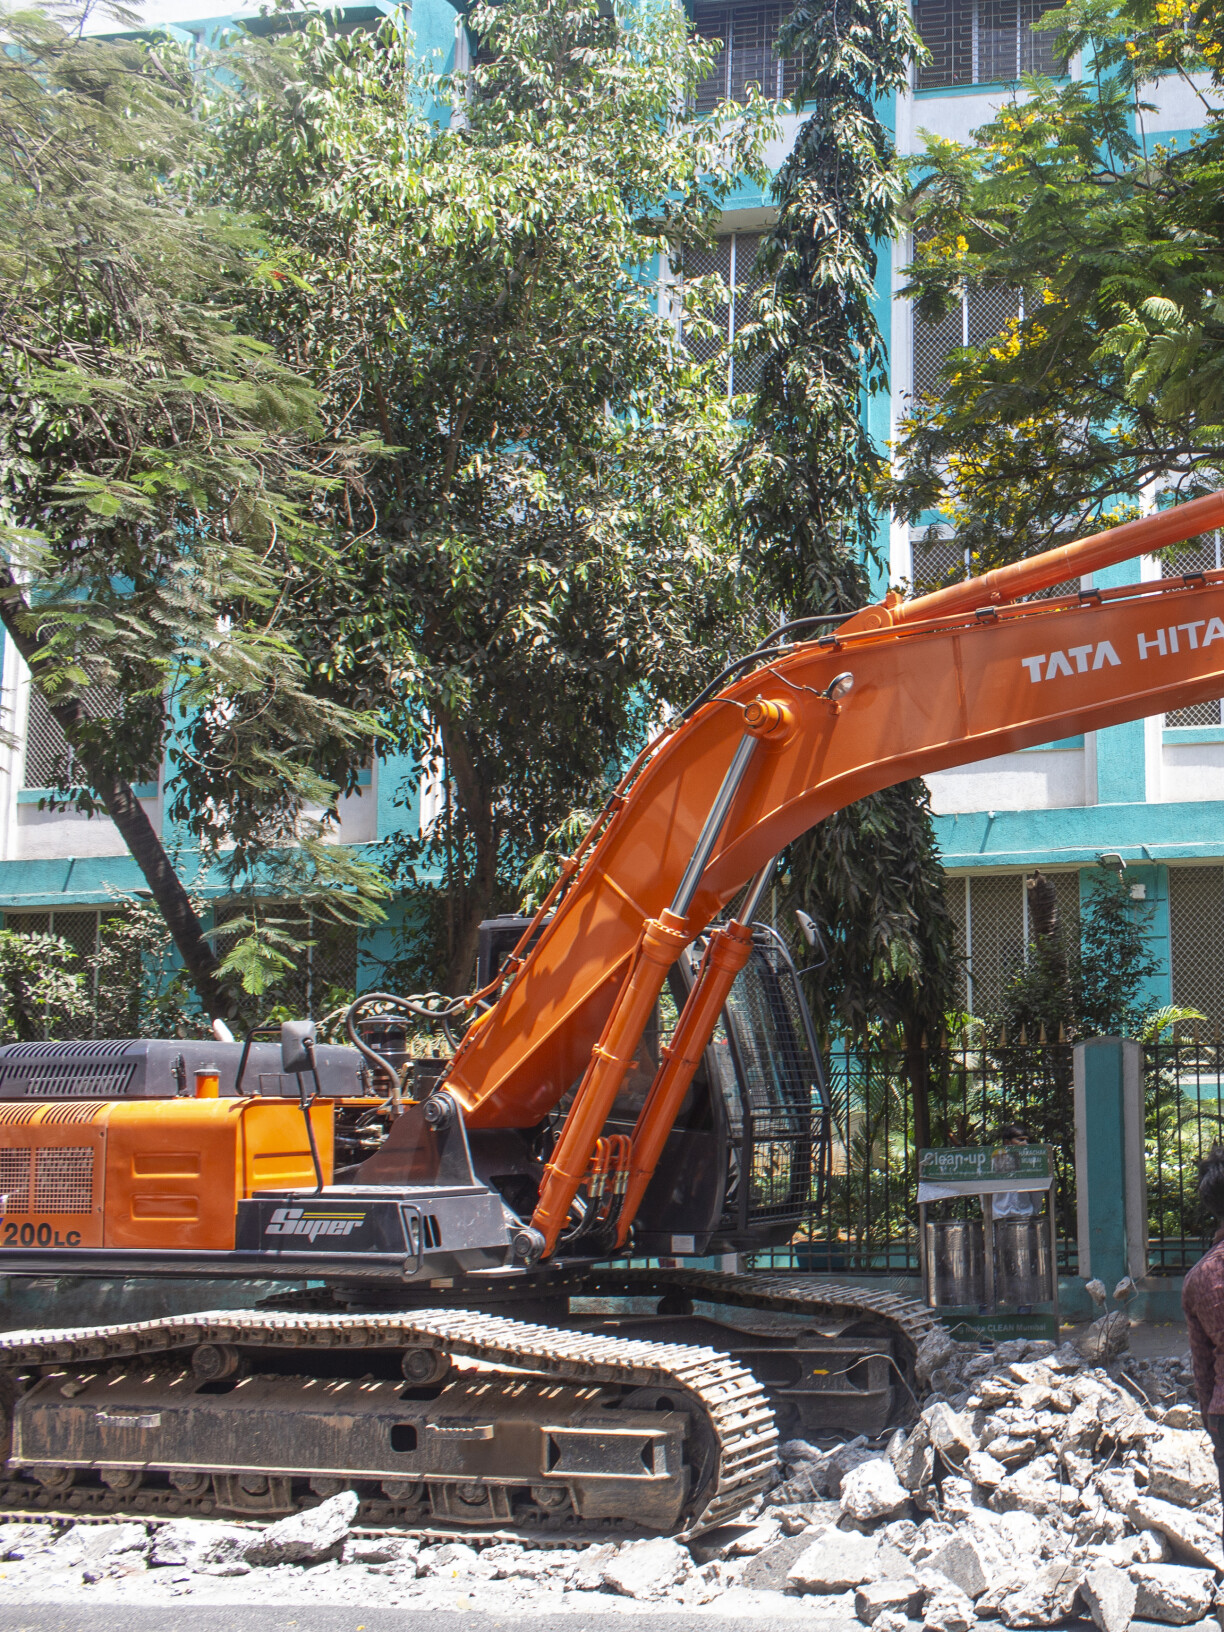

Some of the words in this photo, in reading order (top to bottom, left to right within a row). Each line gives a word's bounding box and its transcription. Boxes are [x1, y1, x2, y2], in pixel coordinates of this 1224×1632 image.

[1022, 640, 1121, 684] TATA
[923, 1151, 986, 1167] Clean-up
[264, 1208, 364, 1243] Super
[987, 1323, 1014, 1332] CLEAN
